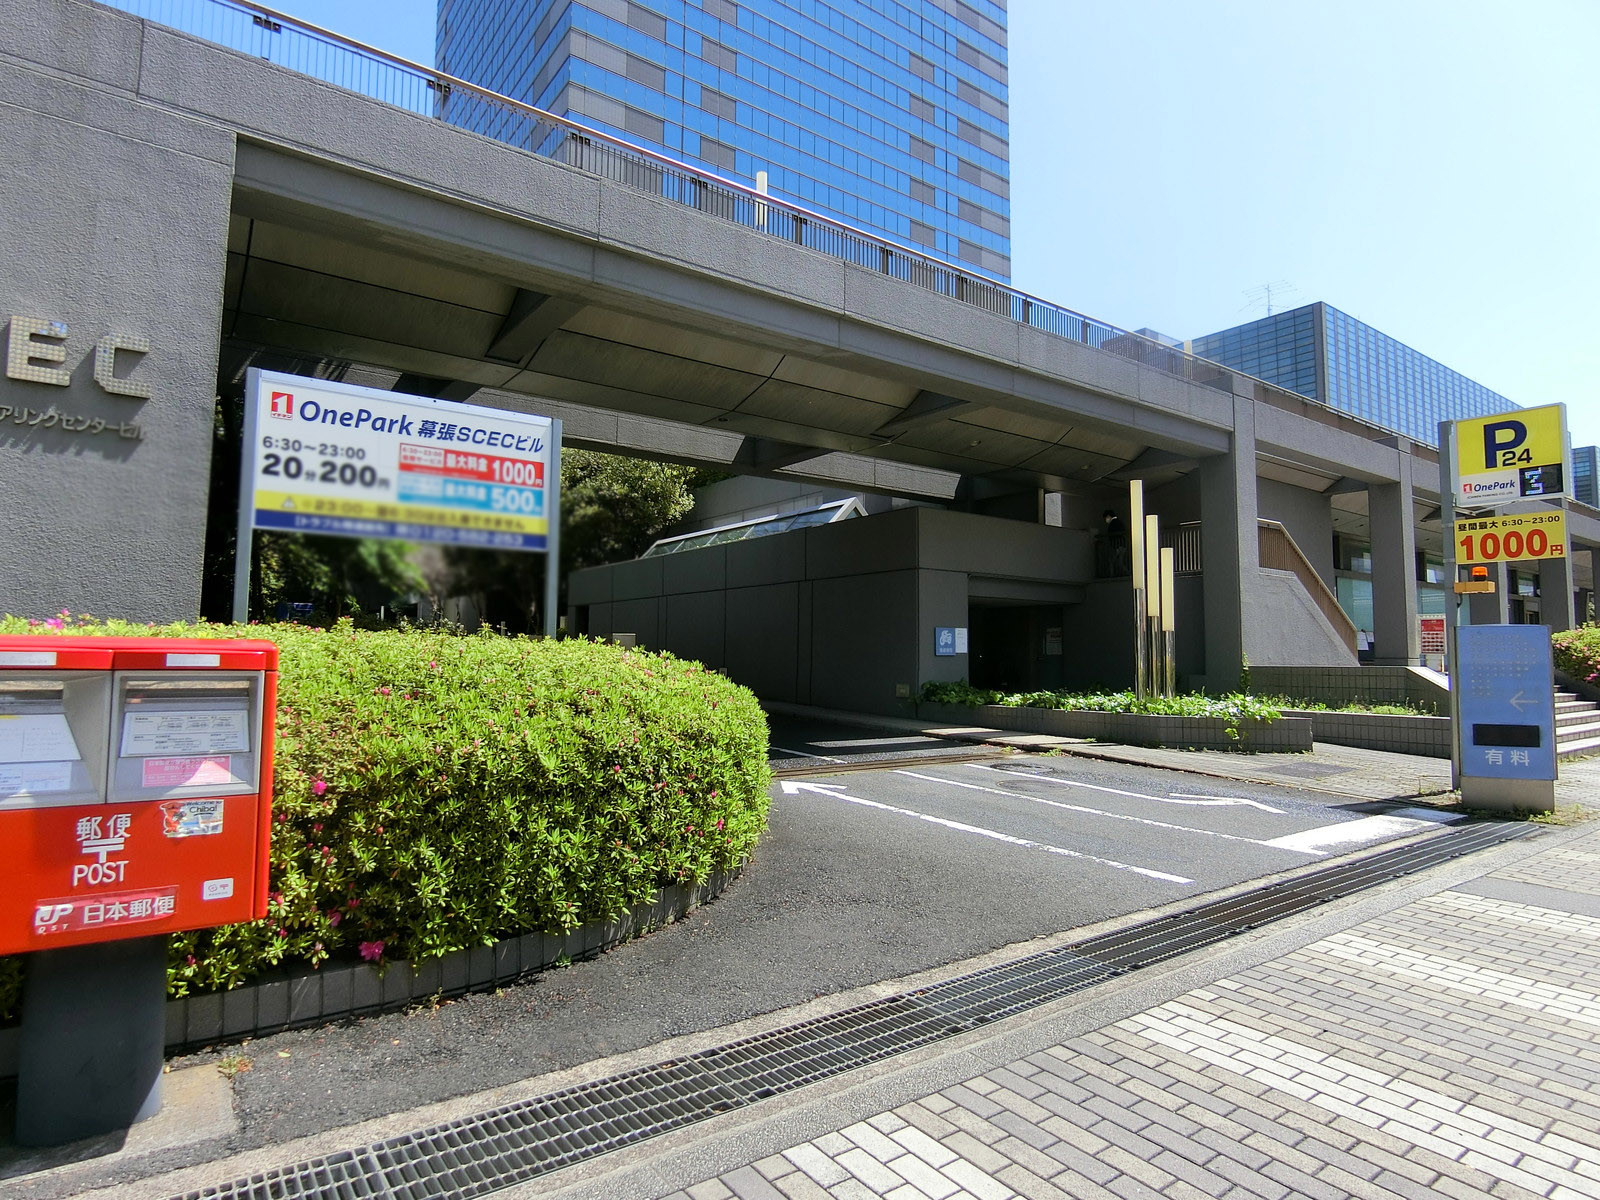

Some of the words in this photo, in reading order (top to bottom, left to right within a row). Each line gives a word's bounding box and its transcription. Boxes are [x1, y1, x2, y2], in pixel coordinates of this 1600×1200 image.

[299, 400, 414, 436] OnePark
[418, 420, 544, 454] 幕張SCECビル
[1474, 479, 1516, 492] OnePark
[1458, 520, 1499, 532] 昼間最大
[1459, 528, 1564, 561] 1000円
[1485, 749, 1530, 766] 有料
[76, 814, 132, 841] 郵便
[72, 860, 129, 886] POST
[83, 896, 175, 925] 日本郵便
